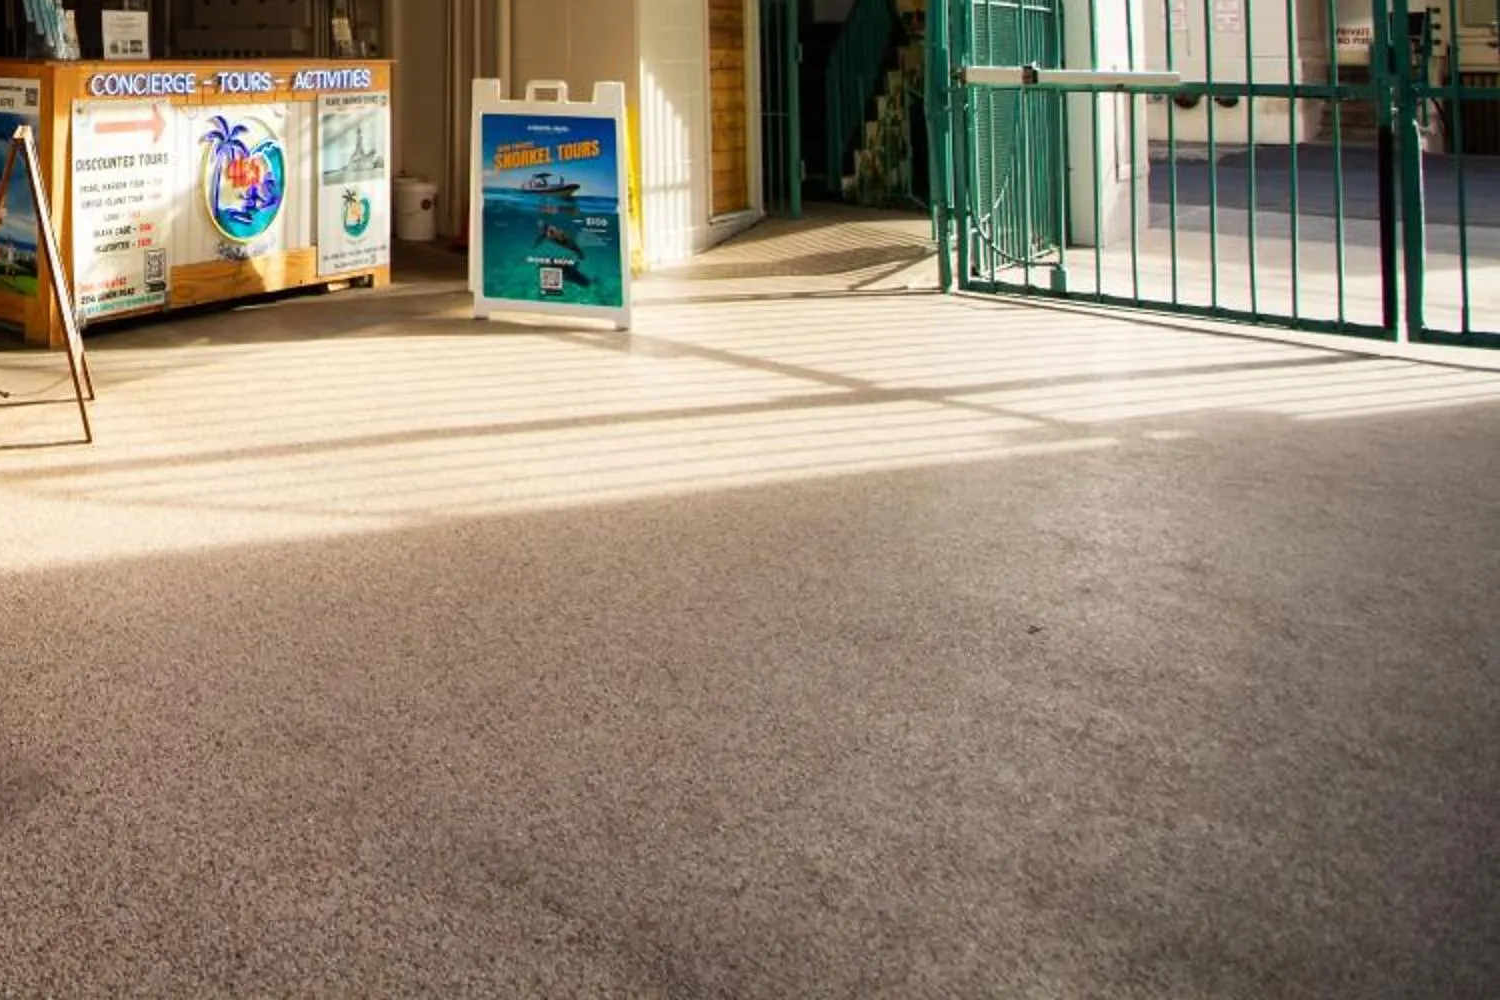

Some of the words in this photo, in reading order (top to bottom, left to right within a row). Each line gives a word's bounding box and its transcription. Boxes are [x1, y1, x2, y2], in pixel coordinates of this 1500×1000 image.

[90, 72, 197, 95] CONCIERGE
[218, 72, 273, 93] TOURS
[293, 69, 372, 89] ACTIVITIES
[75, 155, 136, 172] DISCOUNTED
[139, 152, 169, 167] TOURS
[494, 147, 551, 171] SNORKEL
[557, 140, 600, 161] TOURS
